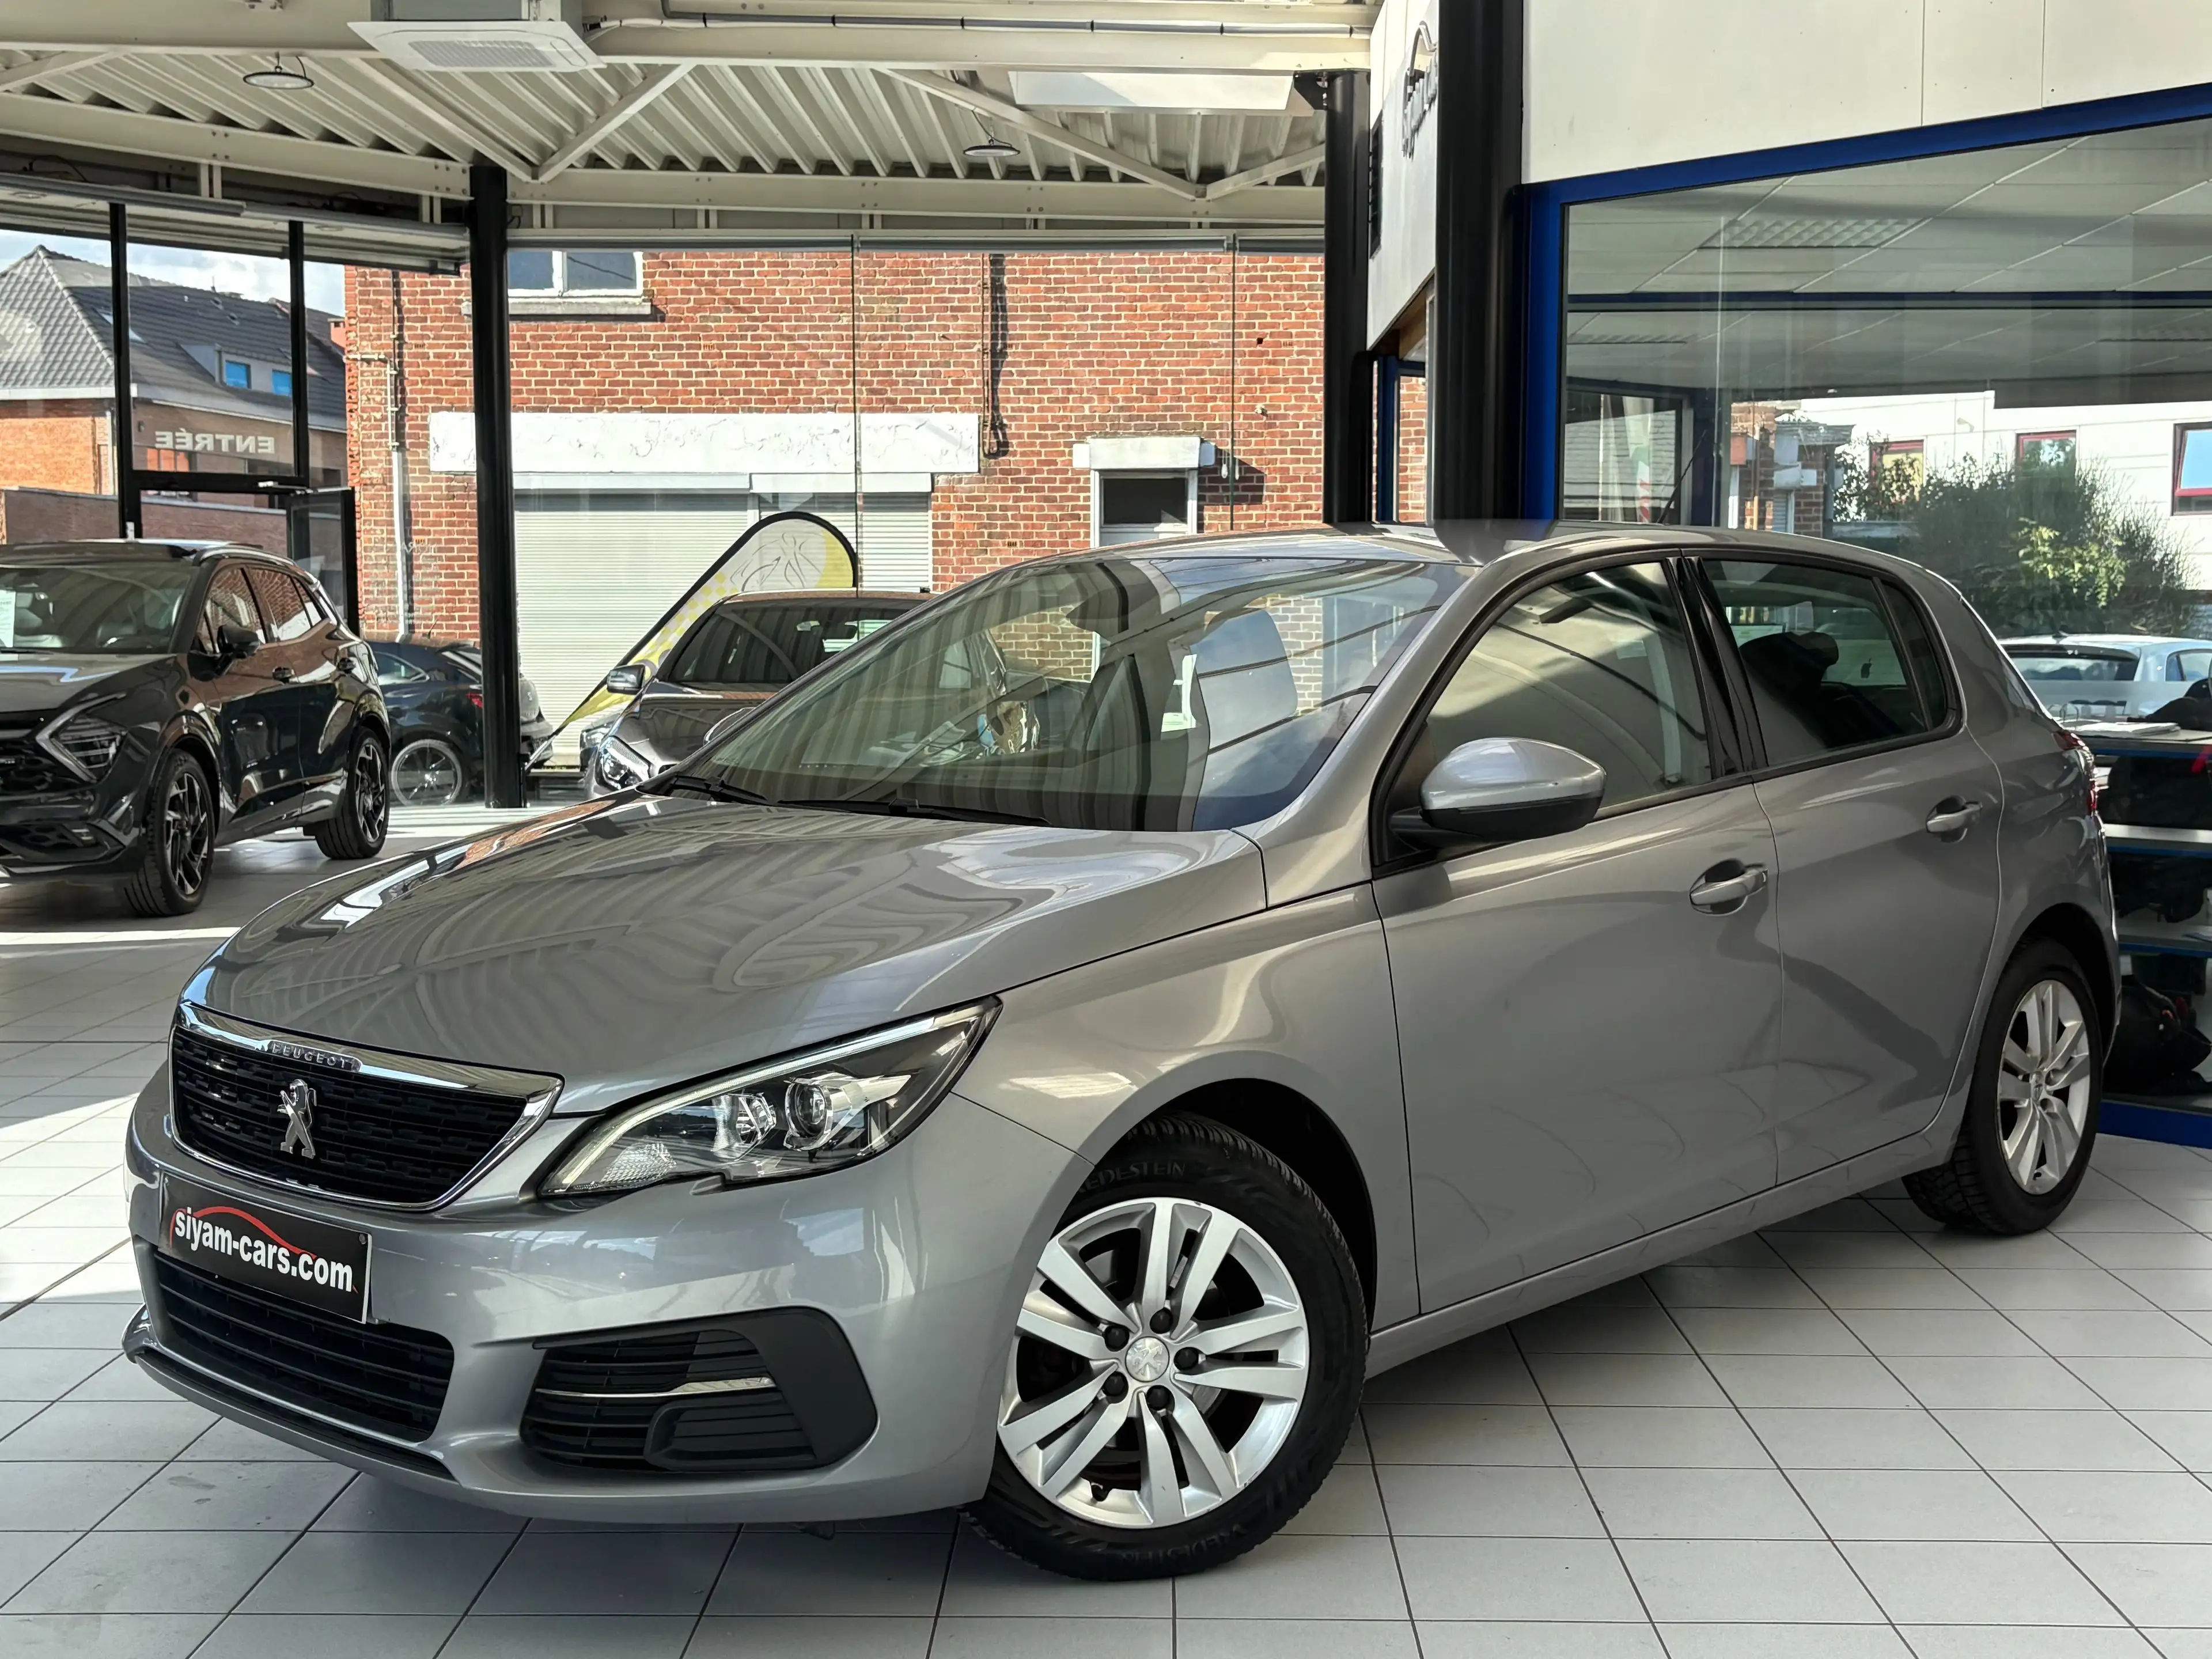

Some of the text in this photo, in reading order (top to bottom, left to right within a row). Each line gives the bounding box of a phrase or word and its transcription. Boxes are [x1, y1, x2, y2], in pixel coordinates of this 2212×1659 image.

[272, 1042, 348, 1068] PEUGEOT
[1078, 1162, 1186, 1193] EDESTEIN
[175, 1207, 353, 1292] siyam-cars.com
